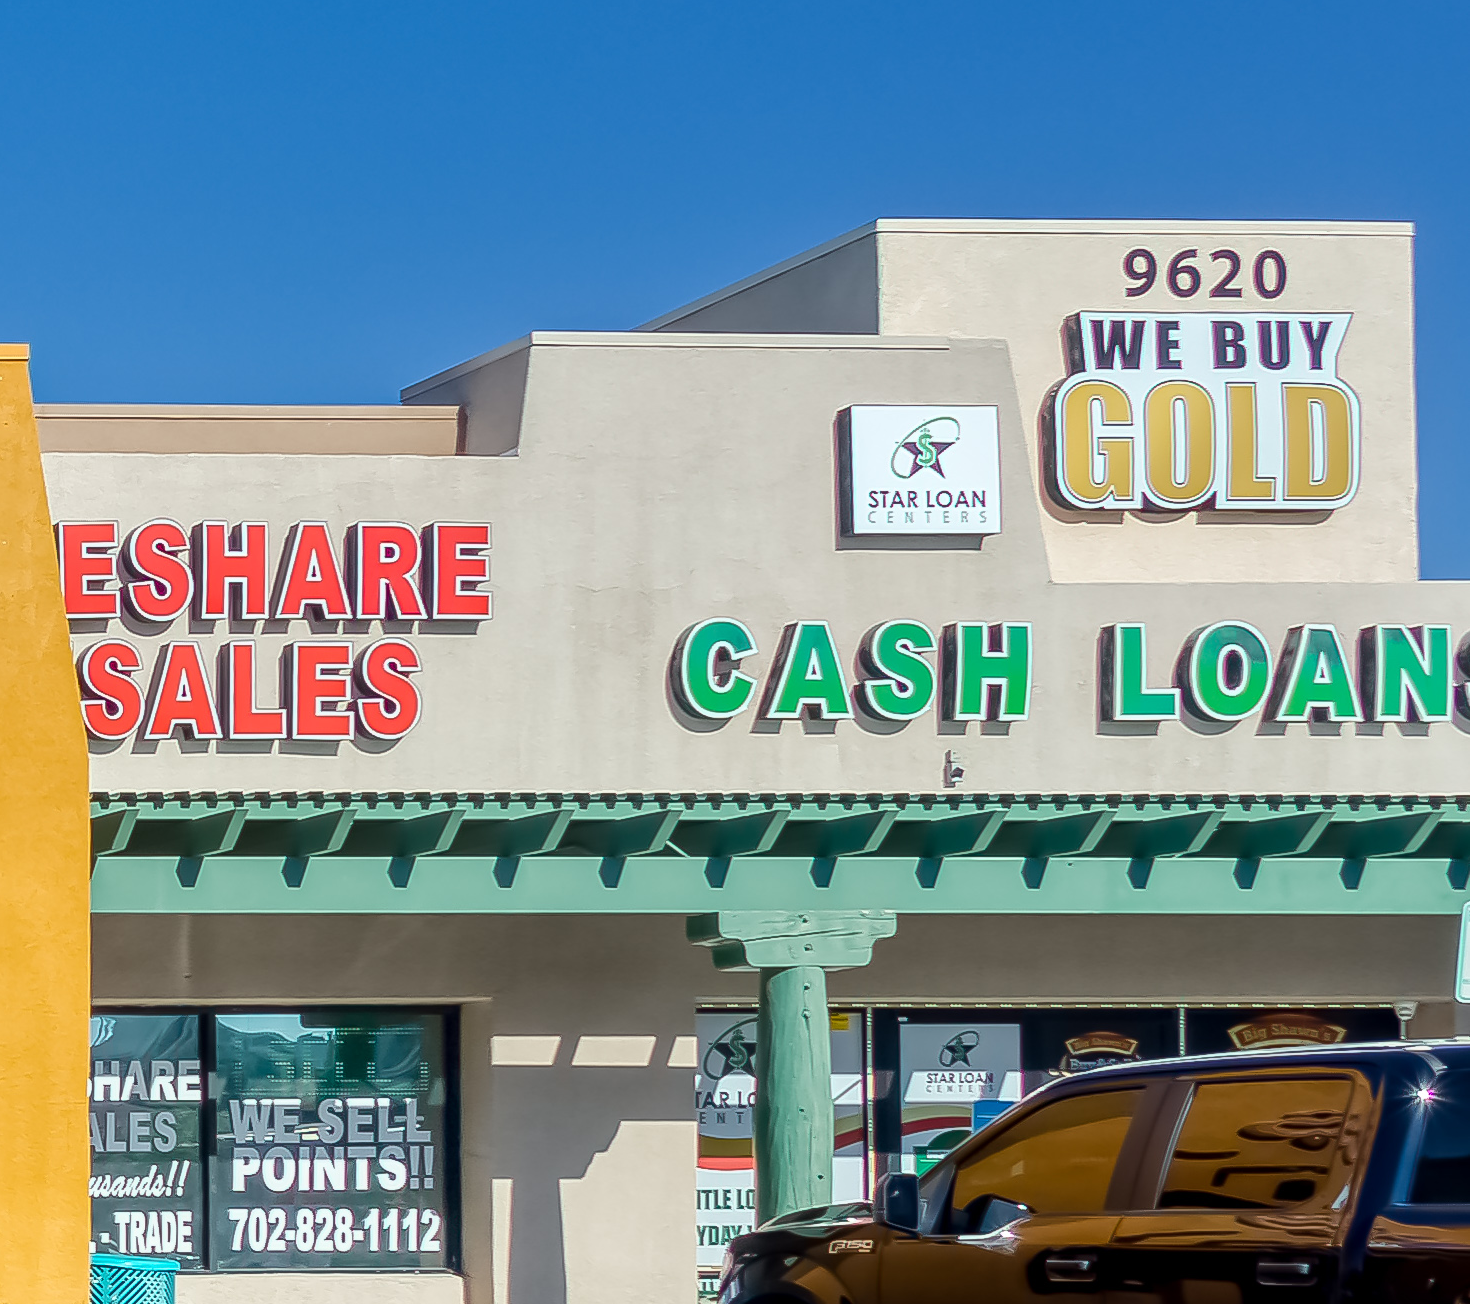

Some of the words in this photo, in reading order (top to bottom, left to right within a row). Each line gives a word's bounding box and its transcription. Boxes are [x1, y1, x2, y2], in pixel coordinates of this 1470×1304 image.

[1123, 248, 1287, 299] 9620
[1089, 319, 1183, 370] WE
[1210, 319, 1334, 371] BUY
[1062, 379, 1352, 503] GOLD
[867, 490, 919, 508] STAR
[926, 490, 987, 508] LOAN
[867, 510, 988, 524] CENTERS
[79, 637, 423, 742] SALES
[680, 617, 1032, 723] CASH
[1107, 619, 1470, 727] LOAN
[86, 1059, 203, 1102] HARE
[926, 1072, 956, 1084] STAR
[959, 1072, 994, 1084] LOAN
[228, 1098, 302, 1145] WE
[316, 1097, 433, 1144] SELL
[231, 1145, 435, 1193] POINTS!!
[112, 1210, 193, 1254] TRADE
[228, 1207, 442, 1253] 702-828-1112
